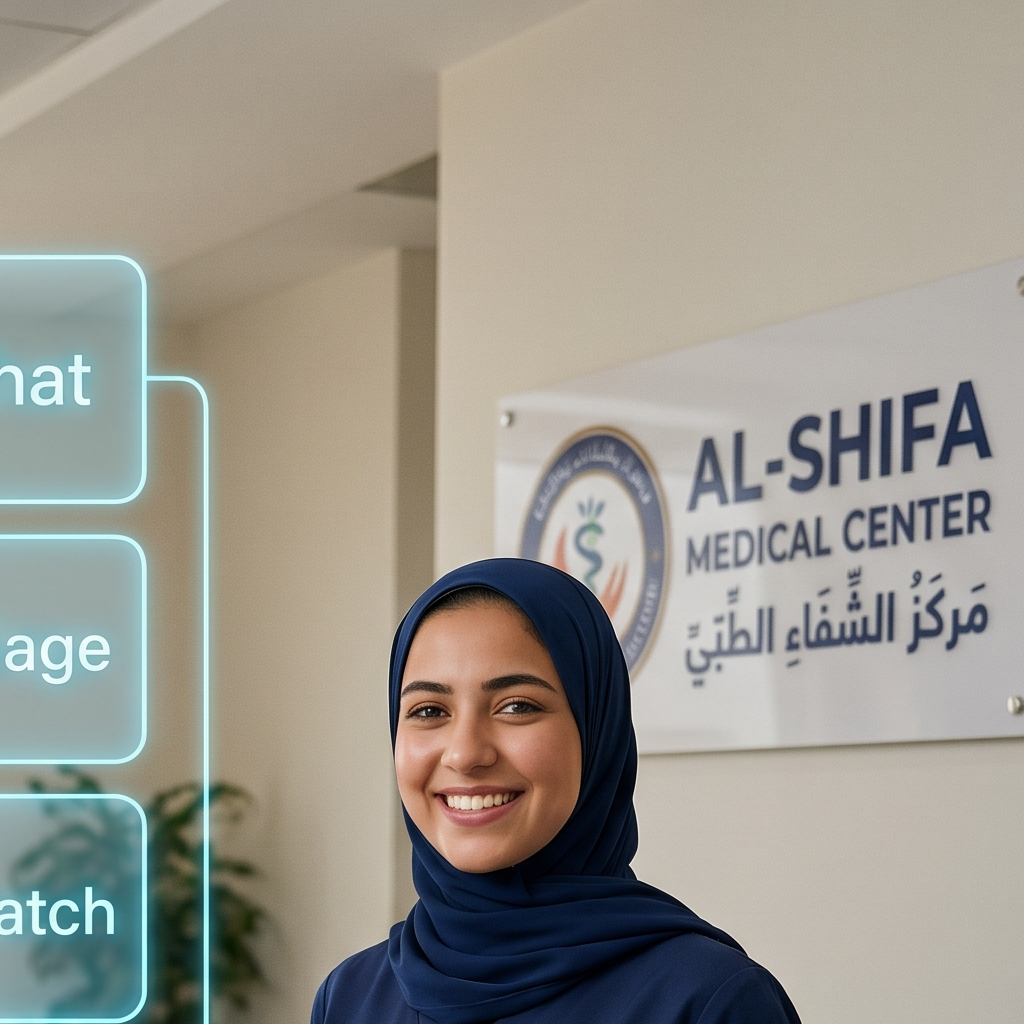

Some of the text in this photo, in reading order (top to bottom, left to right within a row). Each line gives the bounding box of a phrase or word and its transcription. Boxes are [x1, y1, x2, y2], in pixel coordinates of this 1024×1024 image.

[687, 379, 993, 512] AL-SHIFA
[686, 489, 992, 576] MEDICAL CENTER
